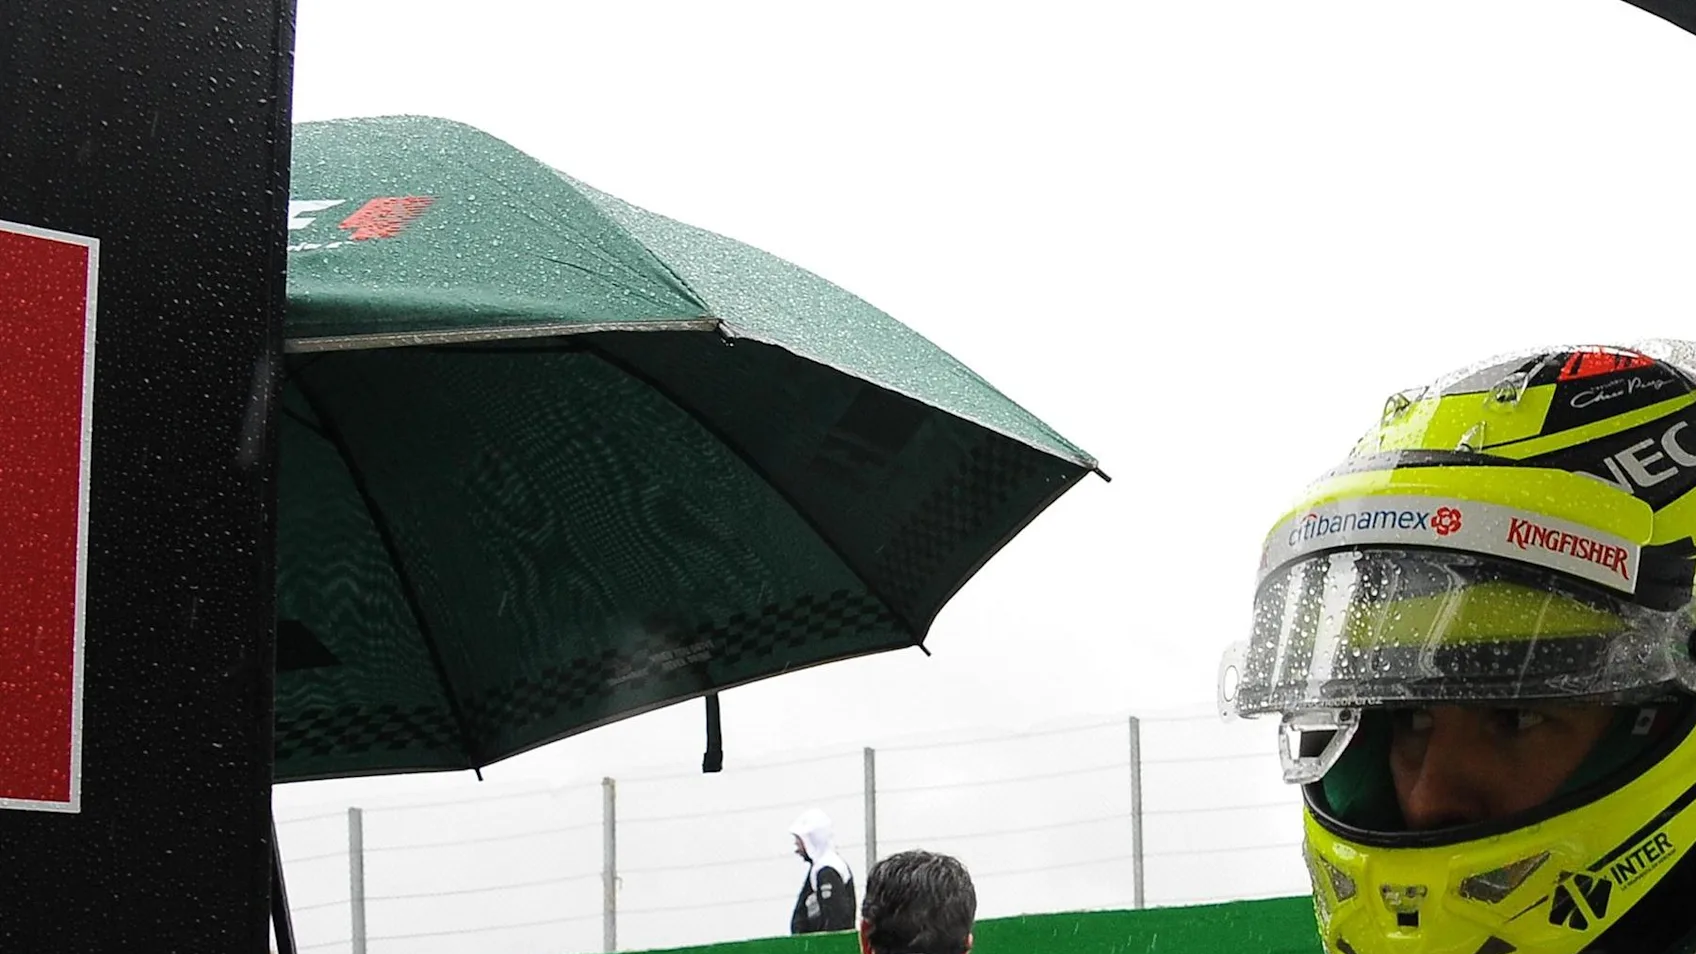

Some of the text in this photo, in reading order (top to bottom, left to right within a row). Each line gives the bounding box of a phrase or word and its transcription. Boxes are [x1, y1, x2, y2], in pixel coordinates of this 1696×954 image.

[1288, 509, 1429, 547] citibanamex
[1507, 516, 1631, 581] KINGFISHER
[1609, 831, 1673, 885] INTER
